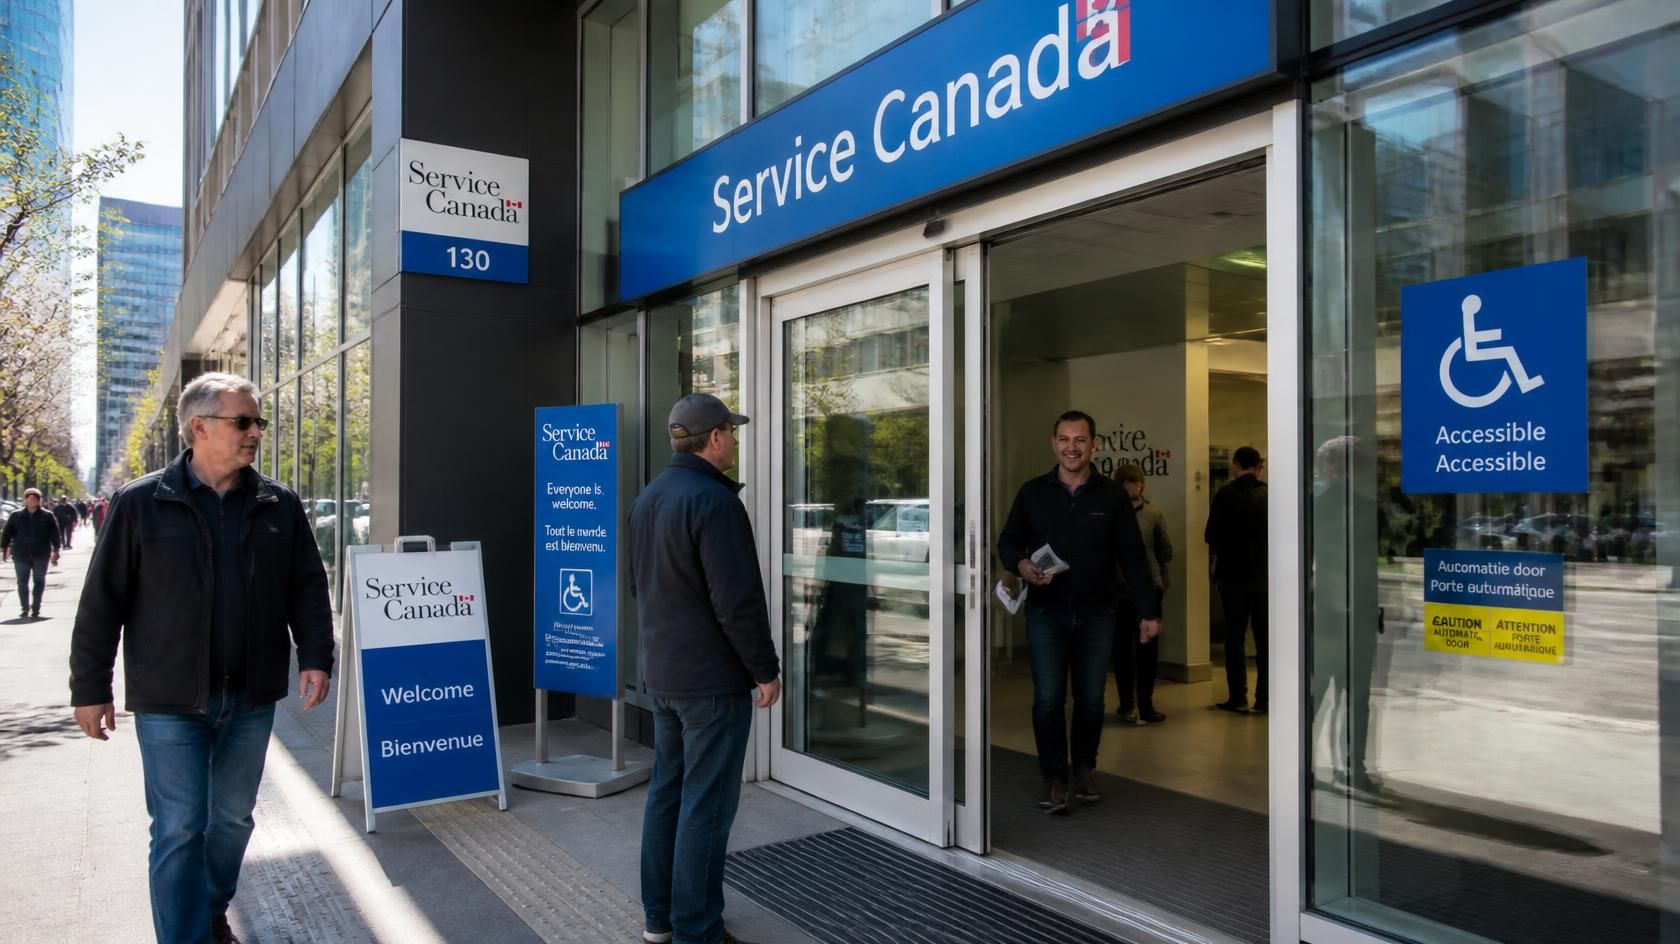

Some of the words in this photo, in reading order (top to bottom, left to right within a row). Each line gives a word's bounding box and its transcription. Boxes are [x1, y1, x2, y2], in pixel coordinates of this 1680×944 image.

[712, 130, 856, 234] Service
[873, 4, 1122, 164] Canada
[409, 160, 500, 197] Service
[426, 190, 520, 224] Canada
[447, 246, 490, 271] 130
[542, 423, 596, 442] Service
[1435, 421, 1546, 445] Accessible
[552, 441, 608, 461] Canada
[1435, 451, 1546, 473] Accessible
[547, 482, 592, 499] Everyone
[552, 498, 597, 510] welcome.
[544, 524, 566, 537] Tout
[567, 524, 576, 537] le
[1514, 562, 1546, 577] door
[366, 576, 452, 600] Service
[1431, 579, 1464, 592] Porte
[383, 595, 474, 621] Canada
[1496, 619, 1556, 635] ATTENTION
[381, 684, 474, 705] Welcome
[381, 733, 484, 758] Bienvenue
